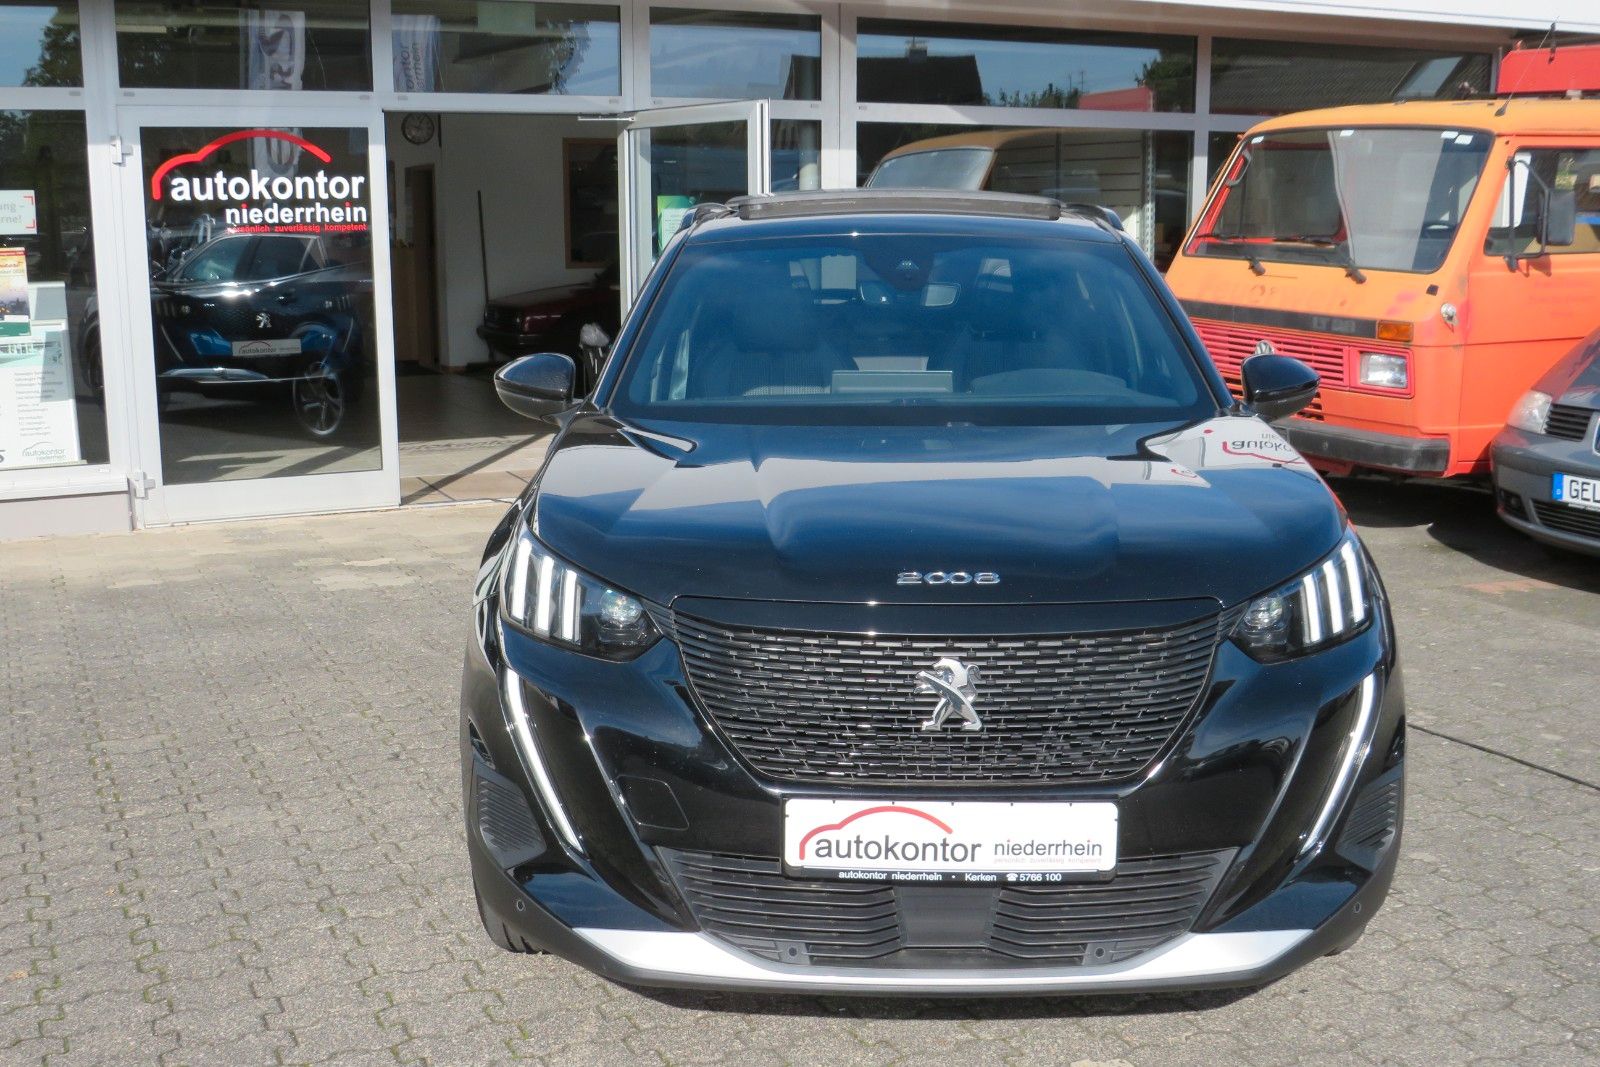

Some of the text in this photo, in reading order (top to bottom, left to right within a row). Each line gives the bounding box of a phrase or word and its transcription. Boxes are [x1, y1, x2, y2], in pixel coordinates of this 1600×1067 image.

[170, 169, 365, 201] autokontor
[225, 202, 367, 224] niederrhein
[226, 223, 367, 233] rsönlich zuverlässig kompetent
[897, 572, 1000, 584] 2008
[814, 835, 1103, 863] autokontor niederrhein
[839, 871, 1062, 882] autokontor niederrhein Kerken 5766 100
